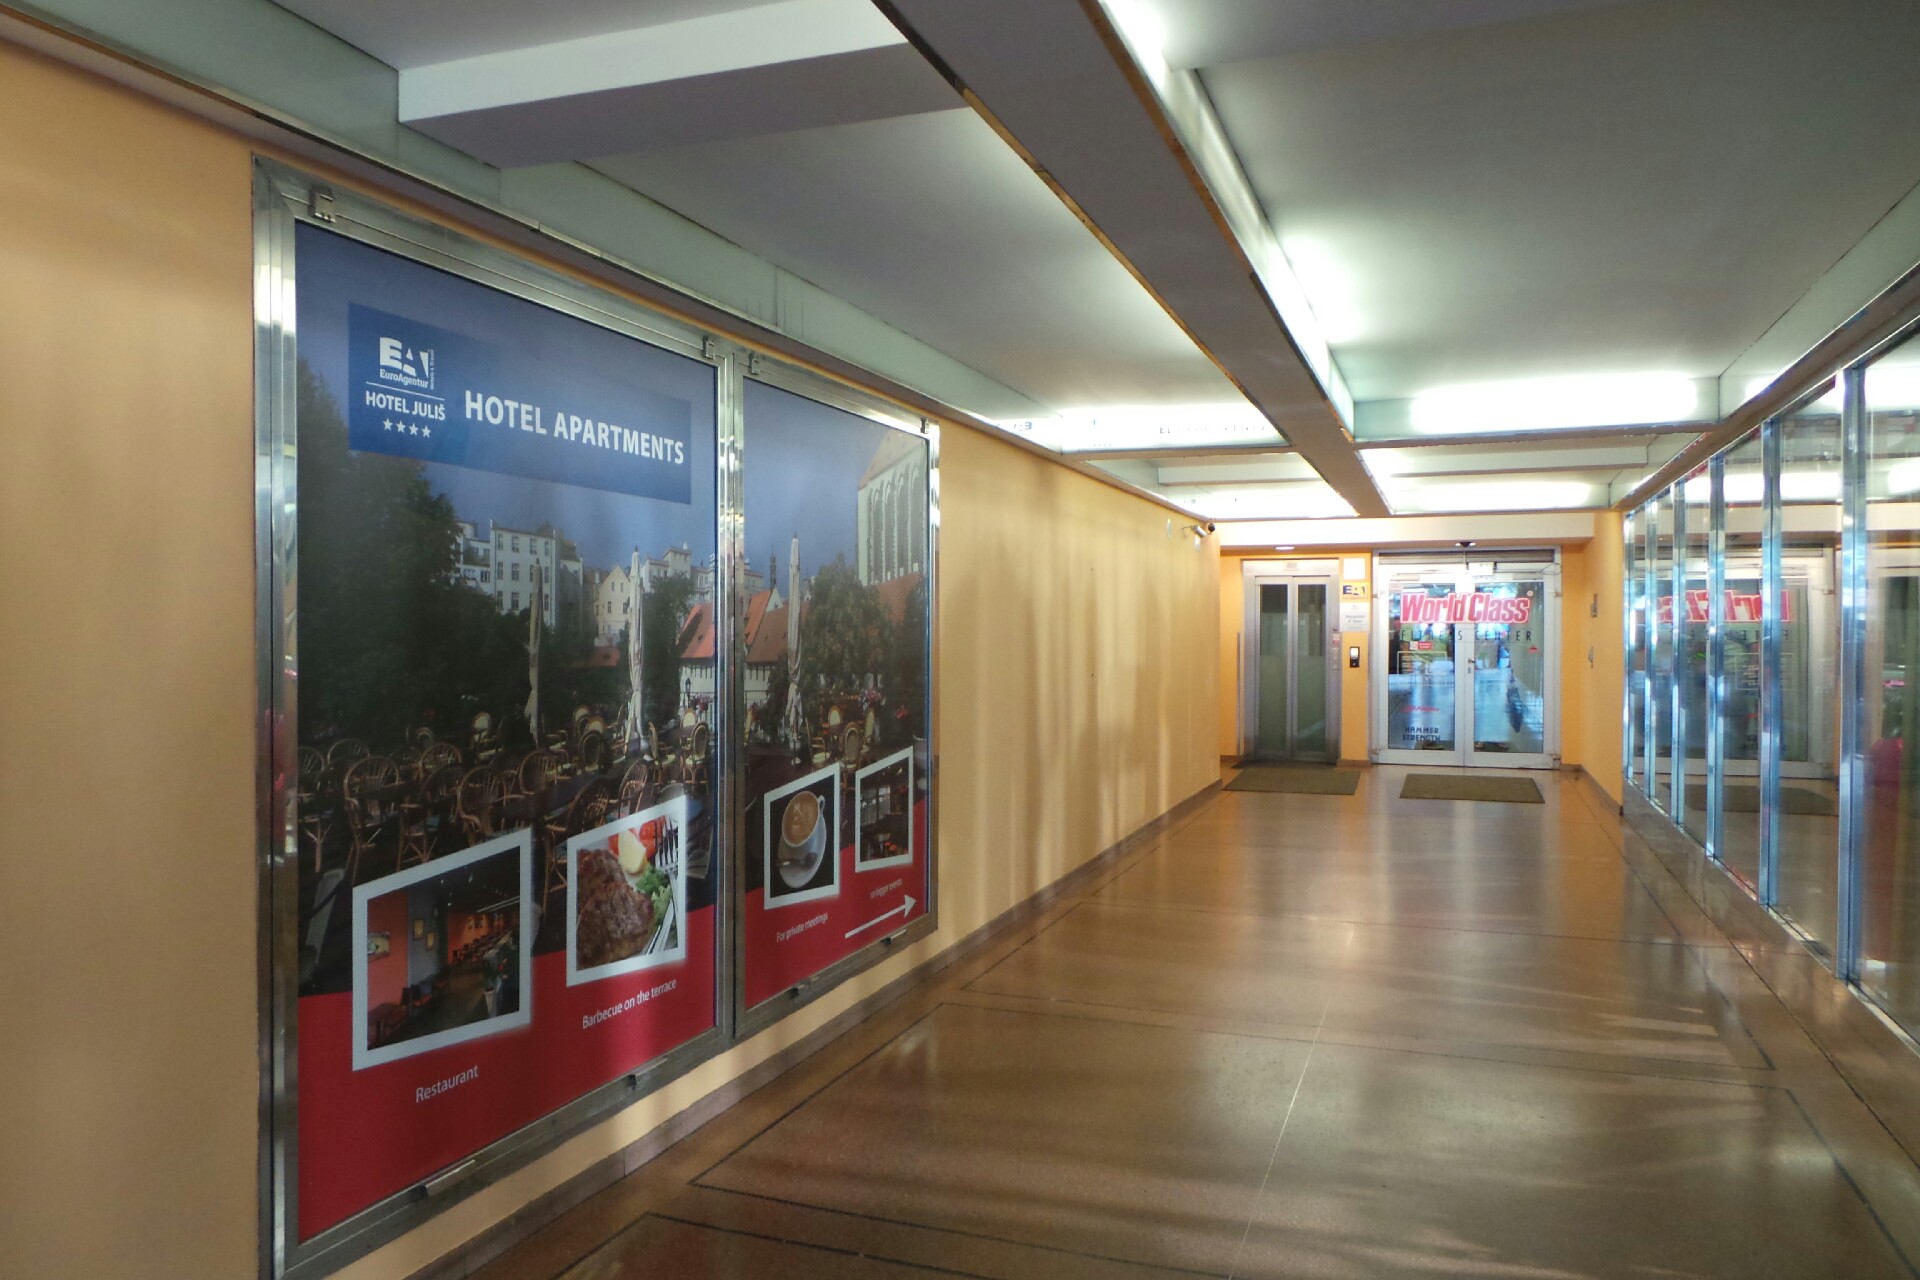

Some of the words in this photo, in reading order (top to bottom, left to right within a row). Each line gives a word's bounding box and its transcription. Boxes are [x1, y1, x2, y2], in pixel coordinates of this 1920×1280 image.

[380, 368, 429, 388] EuroAgentur
[365, 390, 410, 414] HOTEL
[411, 401, 446, 421] JULIŠ
[464, 390, 547, 435] HOTEL
[554, 412, 684, 464] APARTMENTS
[1401, 592, 1467, 623] World
[1467, 592, 1530, 623] Class
[1474, 629, 1533, 642] CENTER
[1404, 726, 1440, 734] HAMMER
[776, 930, 787, 942] For
[786, 923, 805, 941] private
[805, 912, 829, 931] meetings
[582, 1002, 622, 1029] Barbecue
[624, 997, 635, 1010] on
[636, 989, 650, 1005] the
[651, 979, 677, 998] terrace
[416, 1065, 479, 1104] Restaurant
